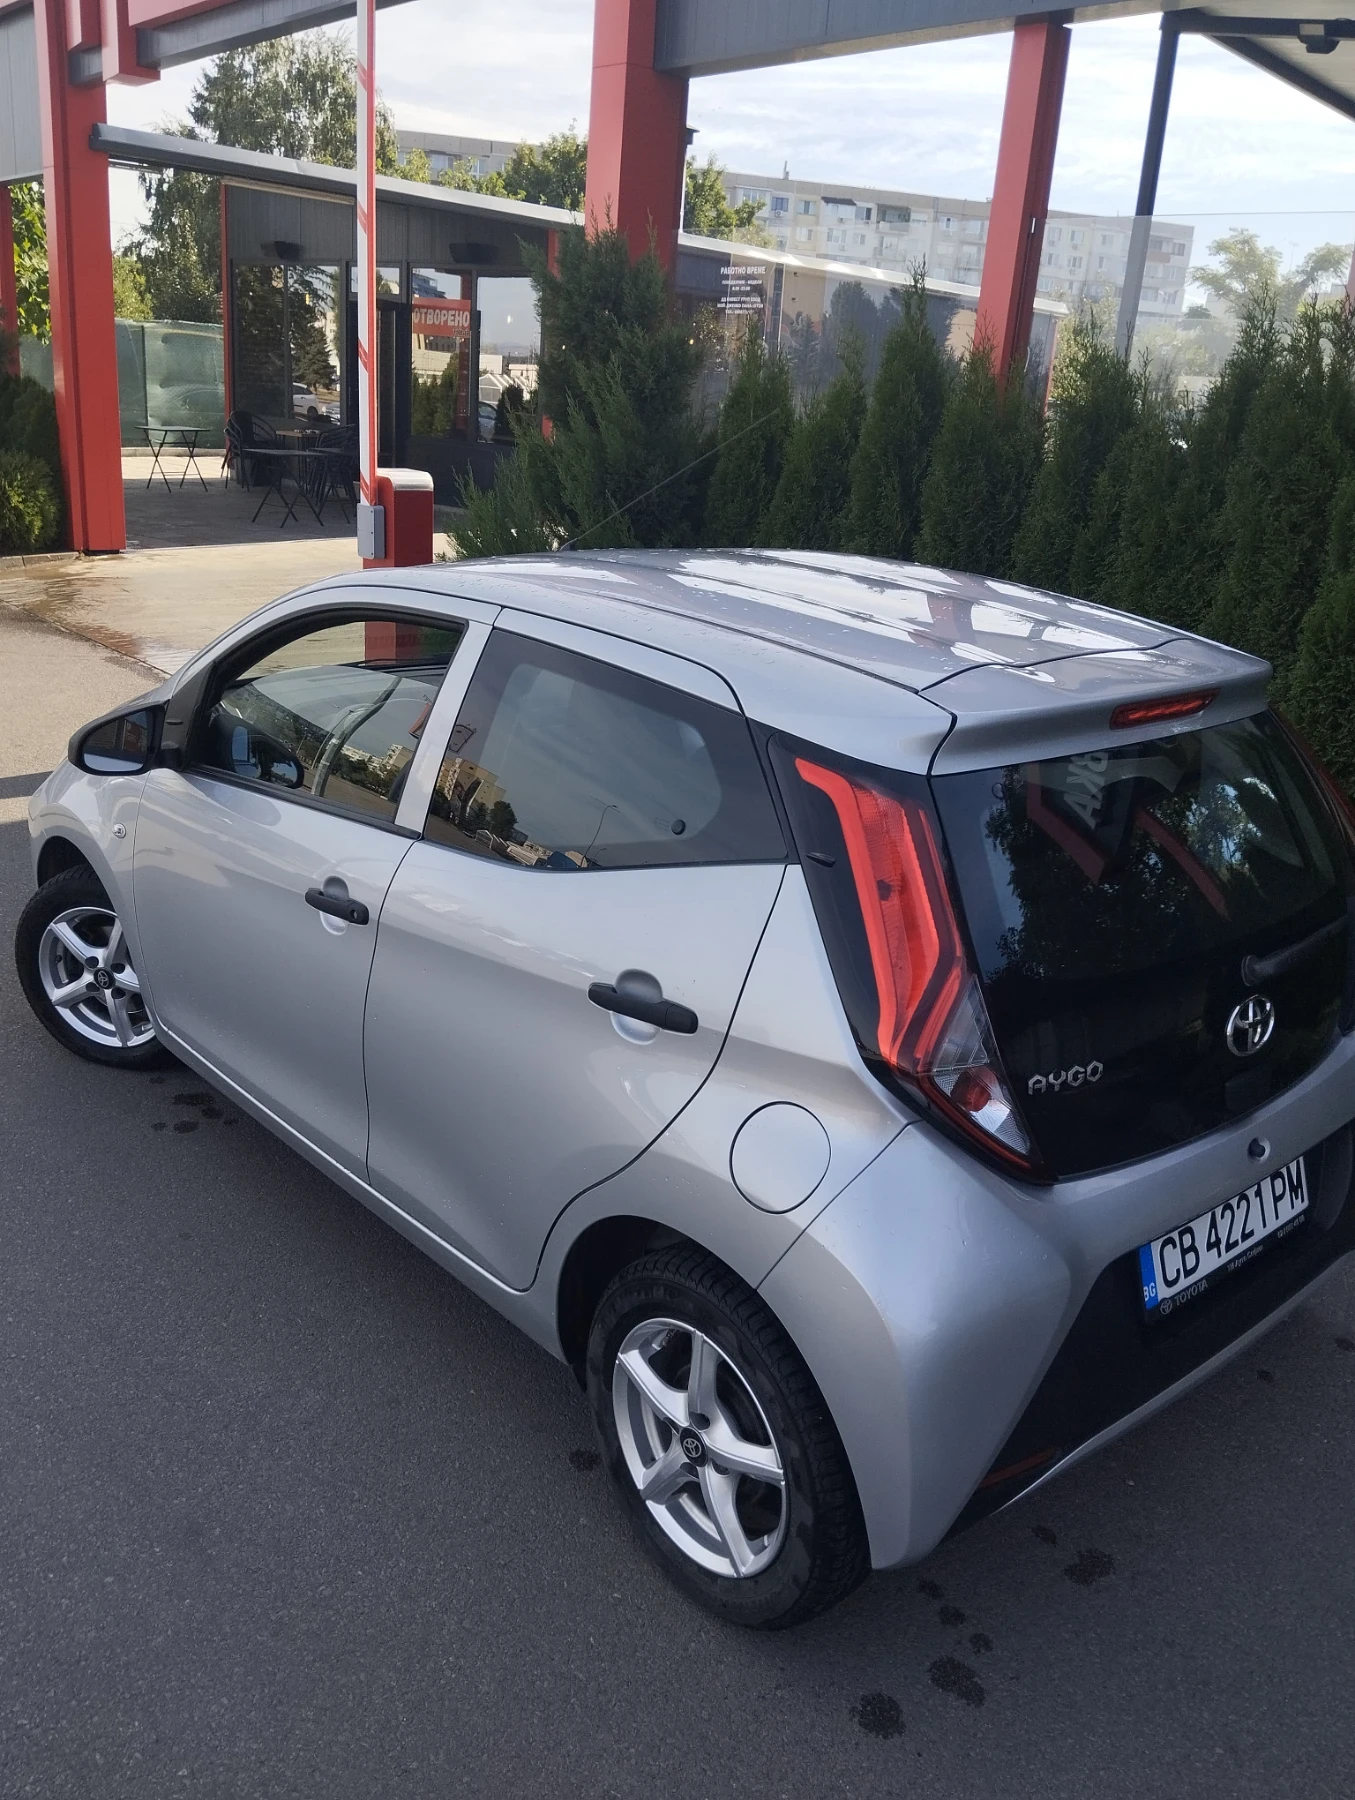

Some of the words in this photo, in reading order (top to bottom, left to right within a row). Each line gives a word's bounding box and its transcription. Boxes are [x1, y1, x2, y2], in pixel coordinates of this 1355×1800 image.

[721, 266, 746, 274] РАБОТНО
[747, 266, 766, 274] ВРЕМЕ
[413, 307, 471, 328] ОТВОРЕНО
[1028, 1060, 1104, 1095] AYGO
[1159, 1225, 1200, 1288] CB
[1206, 1182, 1268, 1259] 4221
[1270, 1158, 1305, 1221] PM
[1143, 1282, 1157, 1302] BG
[1174, 1278, 1209, 1306] TOYOTA
